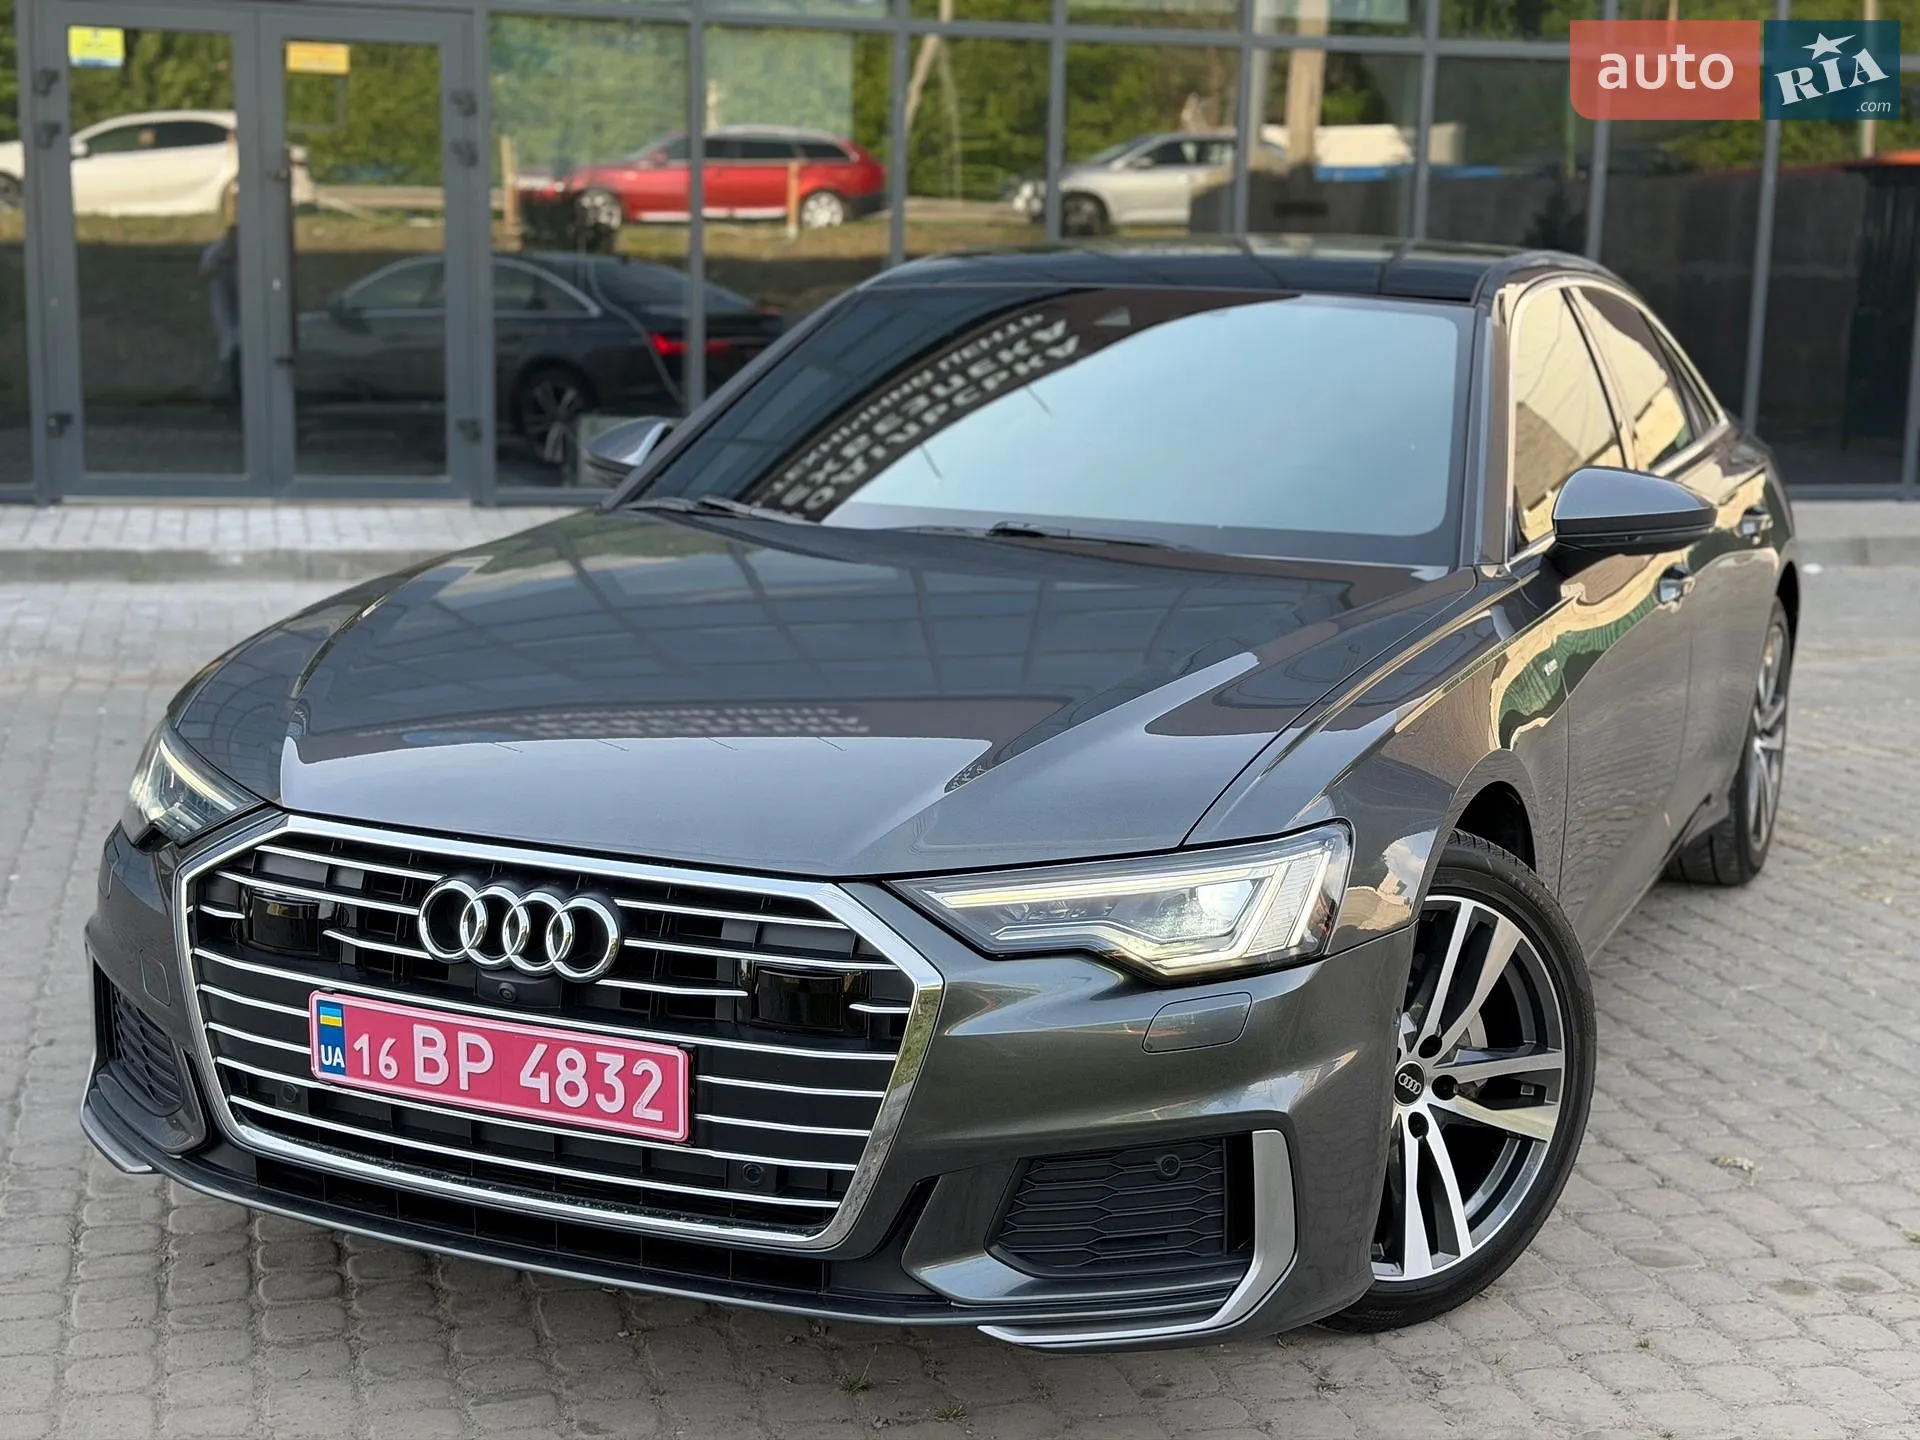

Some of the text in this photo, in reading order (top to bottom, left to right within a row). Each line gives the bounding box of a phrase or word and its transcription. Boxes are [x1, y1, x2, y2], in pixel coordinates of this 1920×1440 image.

[320, 1043, 345, 1069] UA
[352, 1023, 665, 1122] 16 BP 4832
